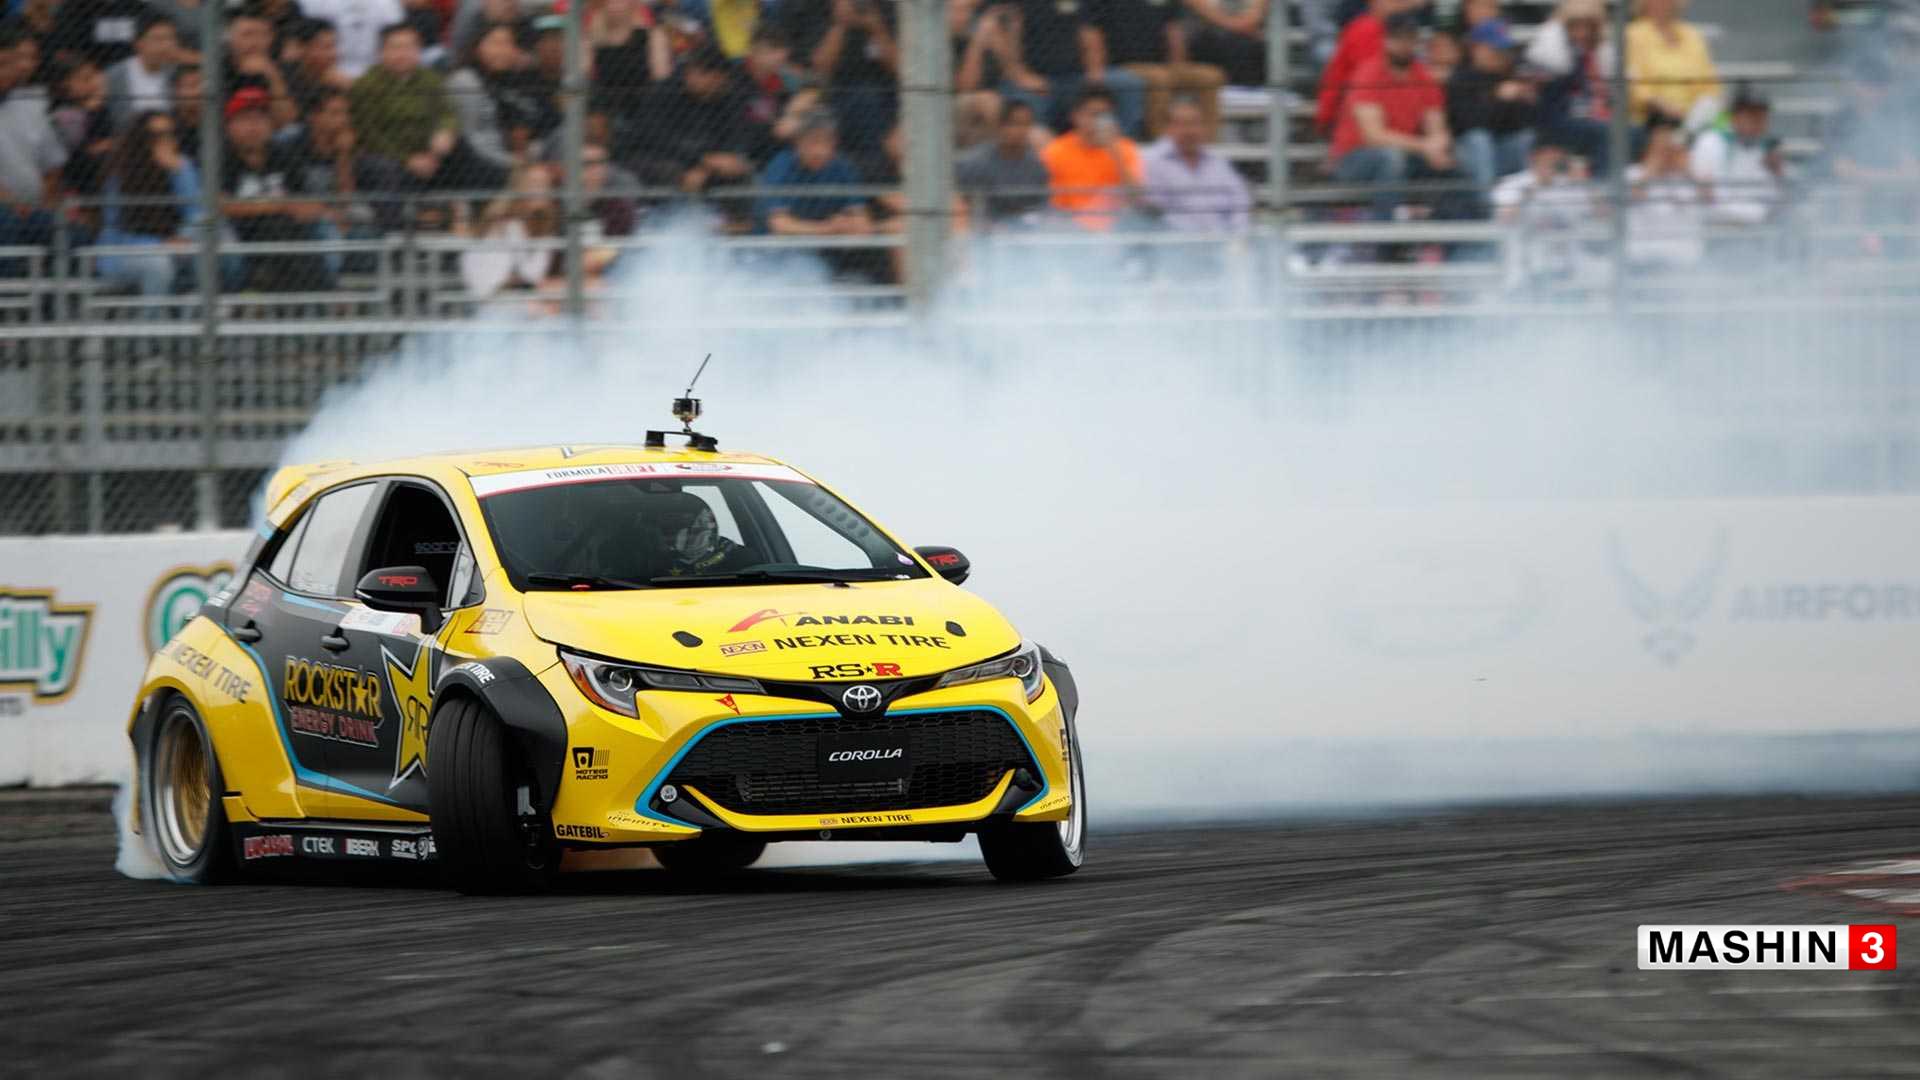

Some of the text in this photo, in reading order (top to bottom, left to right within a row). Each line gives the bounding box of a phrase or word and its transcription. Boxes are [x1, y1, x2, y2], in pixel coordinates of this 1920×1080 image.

[795, 615, 915, 627] ANABI
[774, 634, 876, 650] NEXEN
[880, 634, 952, 650] TIRE
[214, 666, 251, 704] TIRE
[828, 748, 903, 761] COROLLA
[841, 816, 883, 824] NEXEN
[887, 814, 913, 822] TIRE
[556, 824, 604, 838] GATEBIL
[303, 836, 334, 853] CTEK
